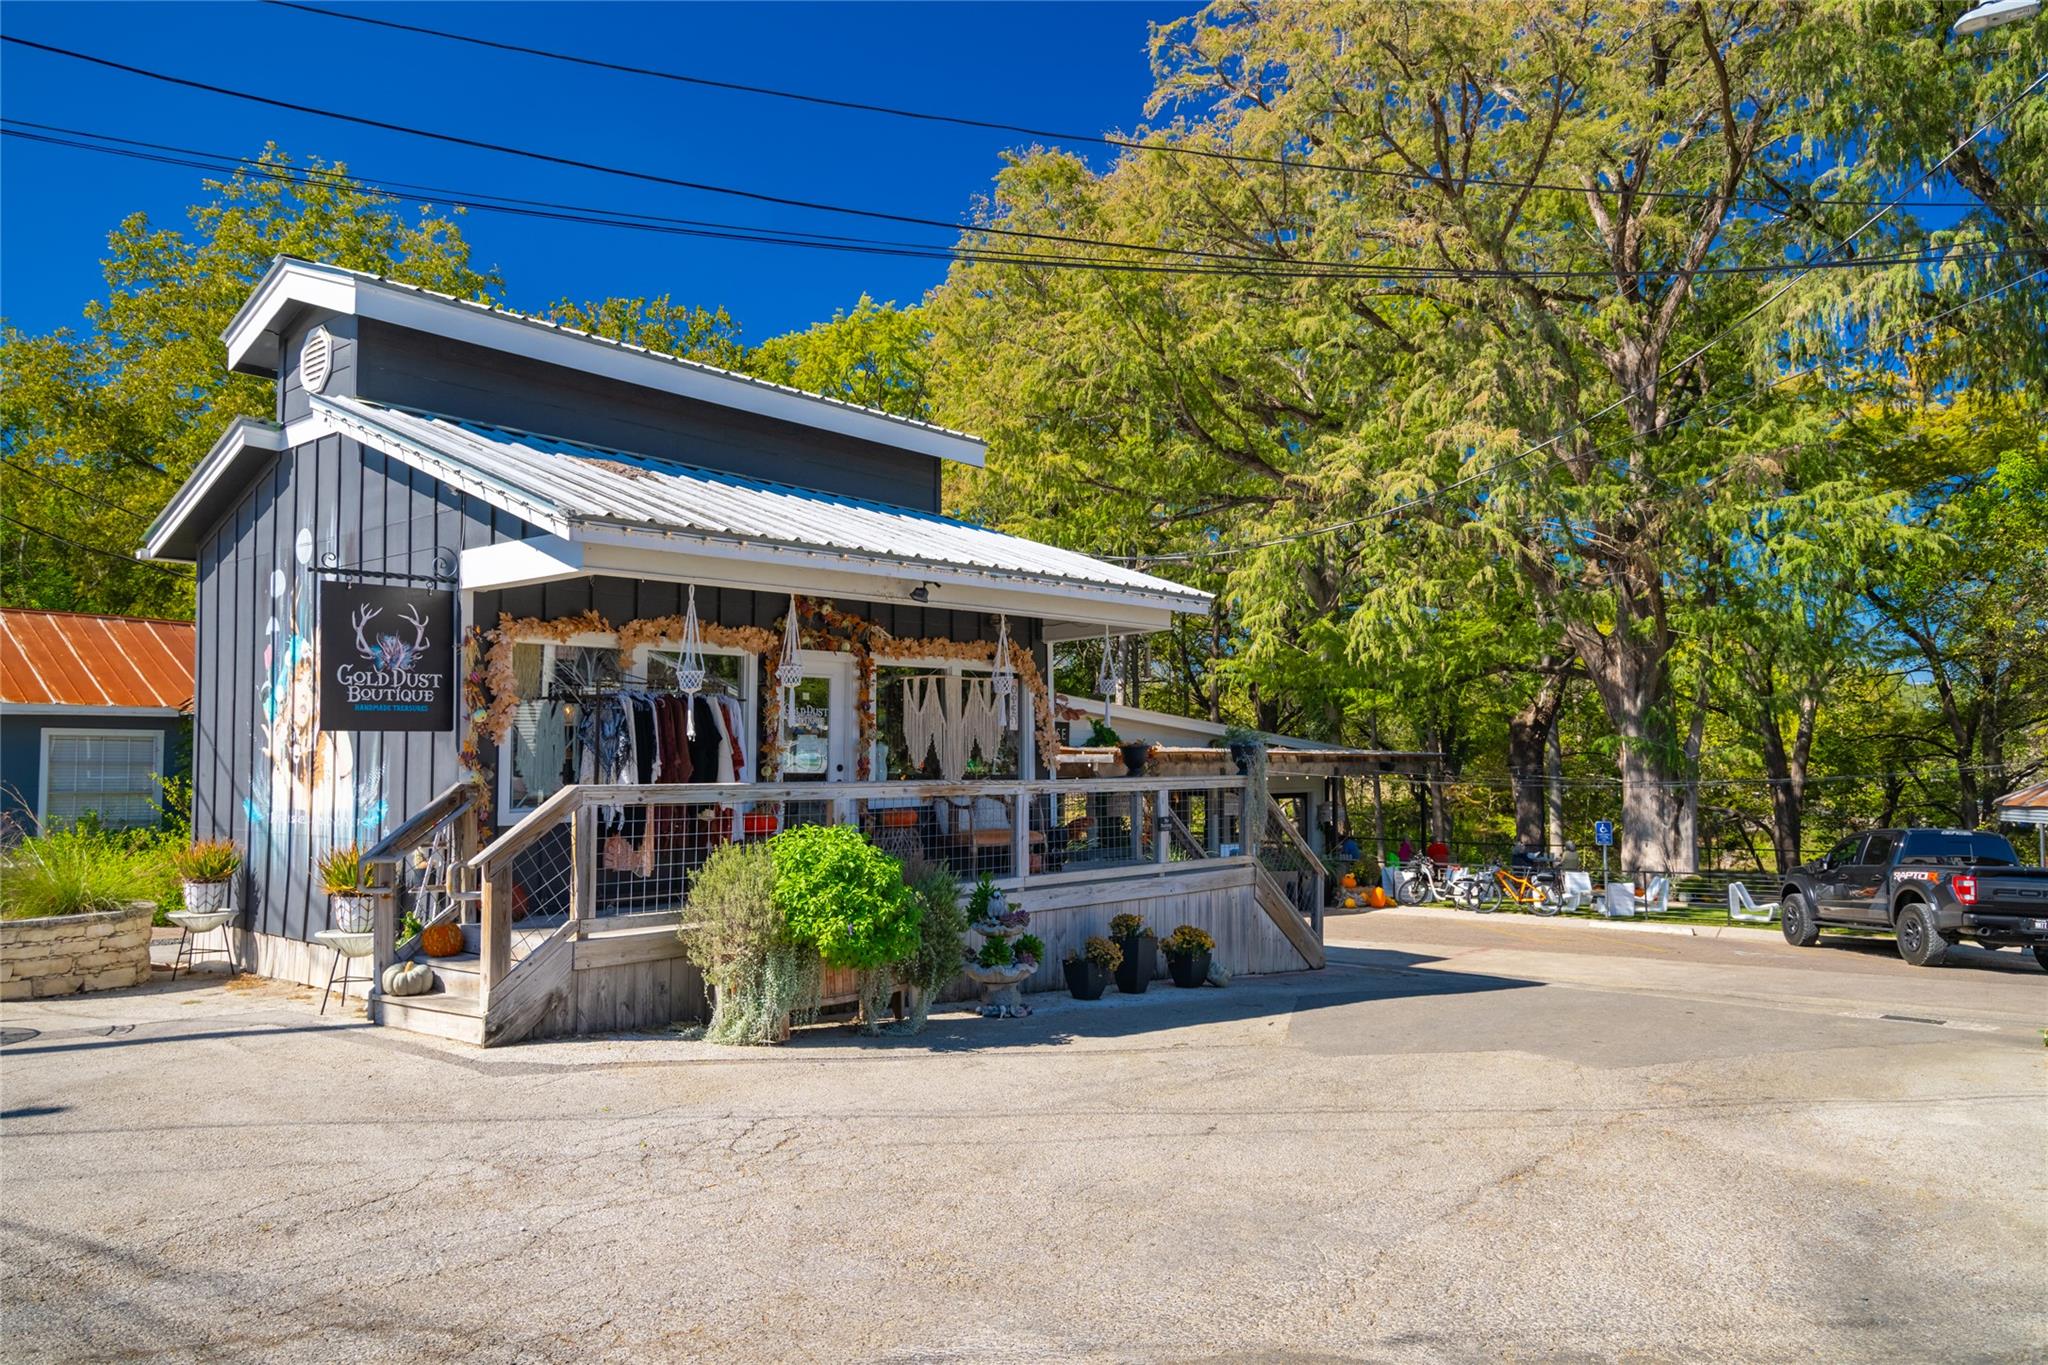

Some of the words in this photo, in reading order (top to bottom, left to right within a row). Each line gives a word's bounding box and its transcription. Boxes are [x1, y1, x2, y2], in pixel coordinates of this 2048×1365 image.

[337, 664, 390, 686] GOLD
[391, 668, 443, 688] DUST
[347, 686, 435, 702] BOUTIQUE
[1893, 871, 1940, 886] RAPTOR
[1992, 887, 2048, 898] FO
